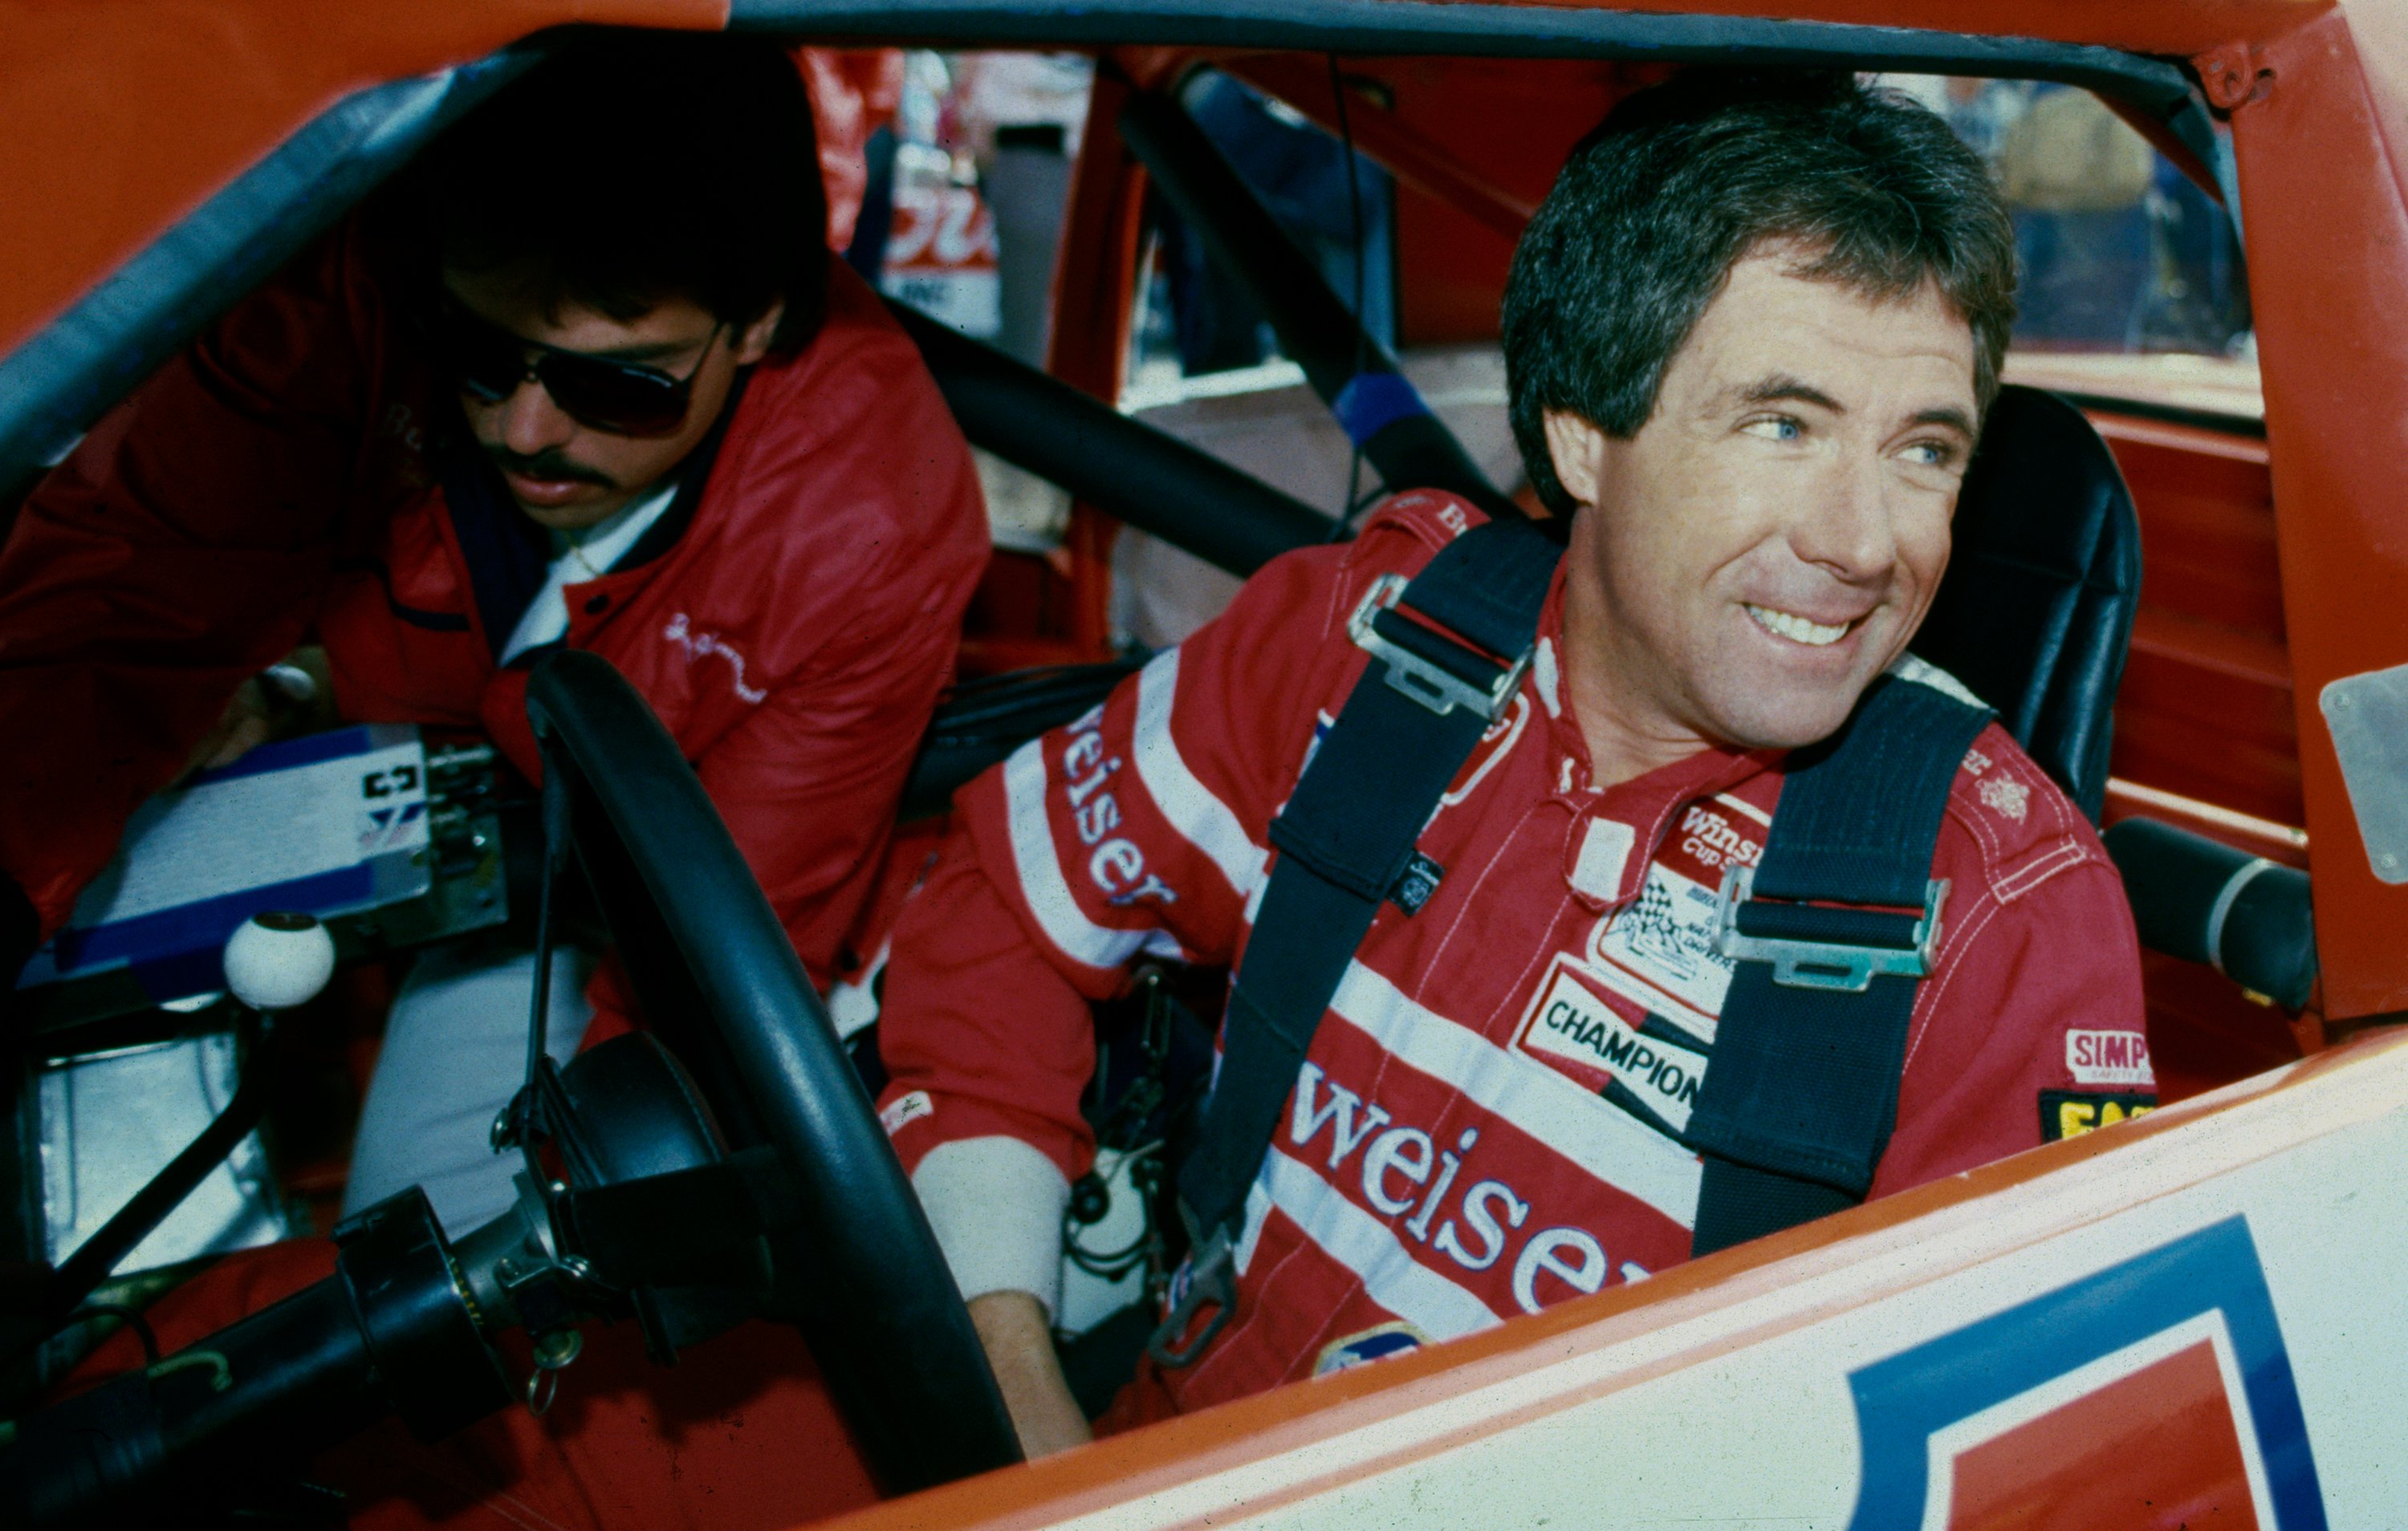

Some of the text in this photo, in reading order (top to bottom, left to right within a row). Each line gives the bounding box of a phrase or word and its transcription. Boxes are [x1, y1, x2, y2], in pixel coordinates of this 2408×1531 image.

[1682, 837, 1722, 867] Cup
[1546, 999, 1702, 1112] CHAMPION
[2075, 1035, 2146, 1068] SIMP
[1290, 1061, 1655, 1318] weise
